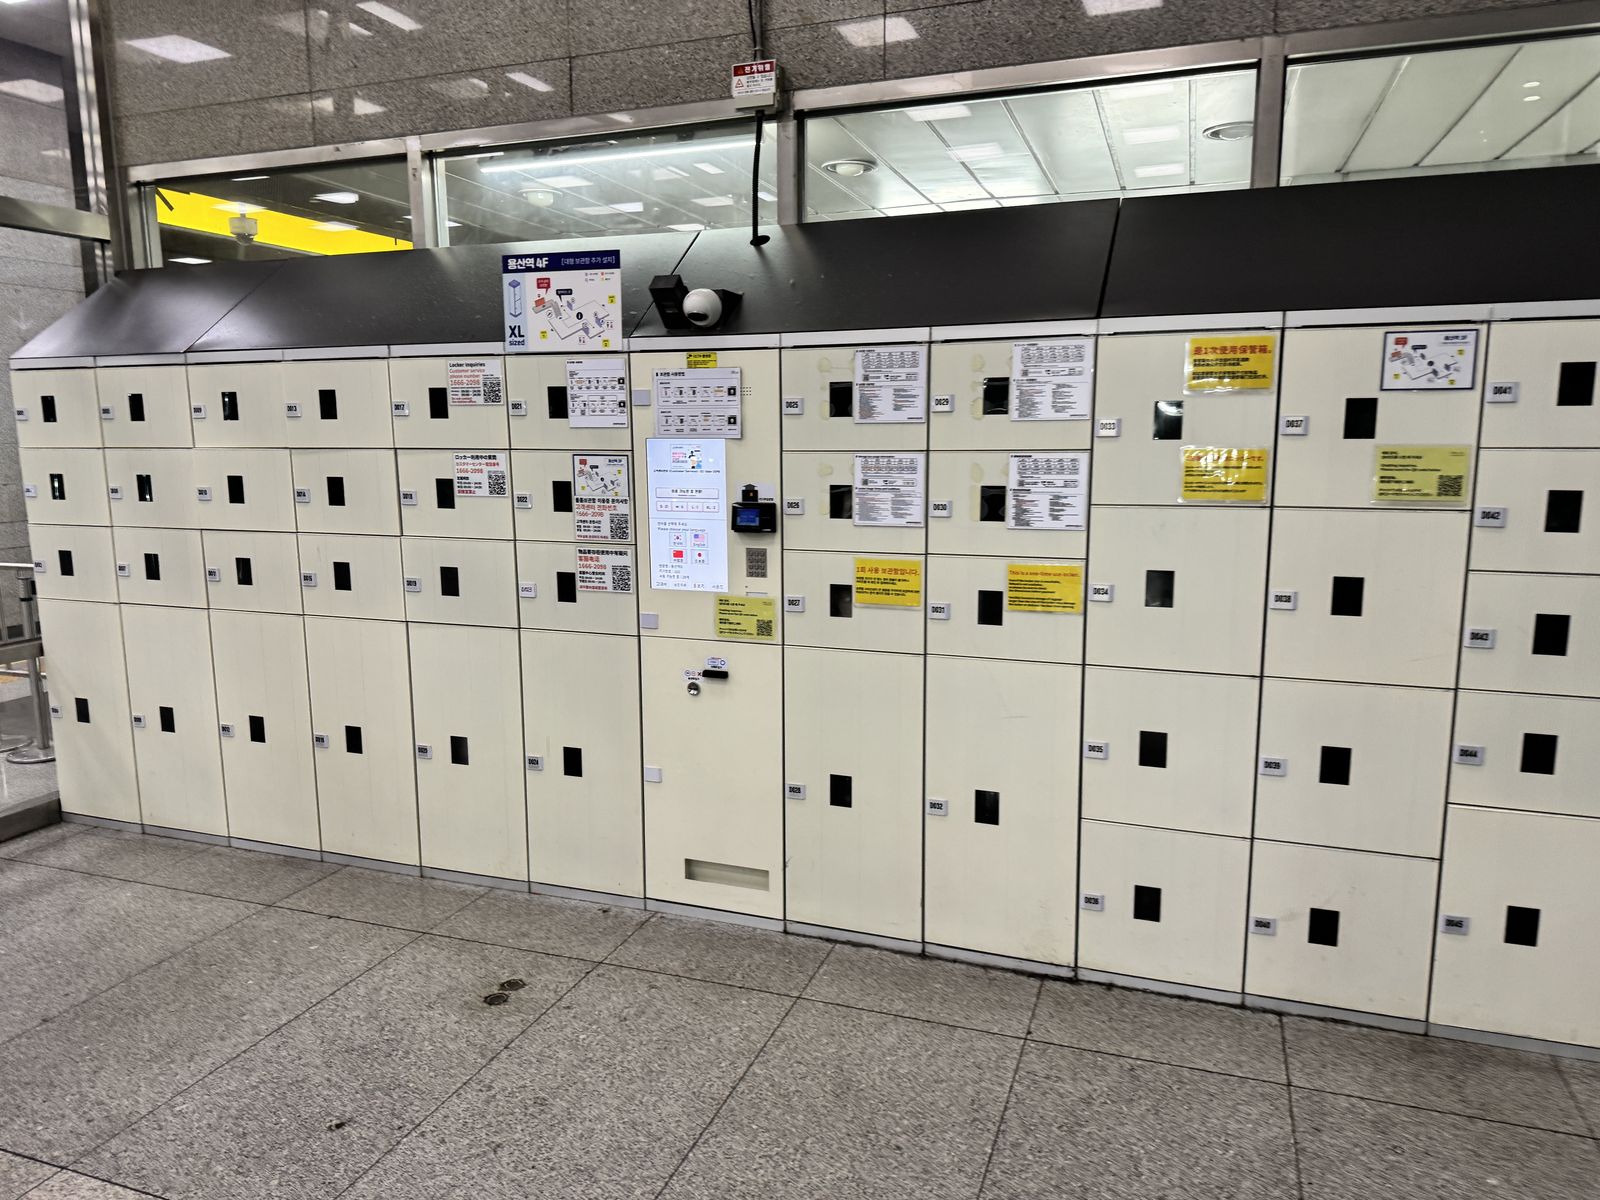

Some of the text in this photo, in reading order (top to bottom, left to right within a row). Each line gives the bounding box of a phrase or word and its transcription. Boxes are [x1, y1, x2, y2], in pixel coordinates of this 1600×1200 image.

[507, 257, 549, 270] 용산역 4F
[508, 325, 525, 338] XL
[508, 338, 525, 346] sized
